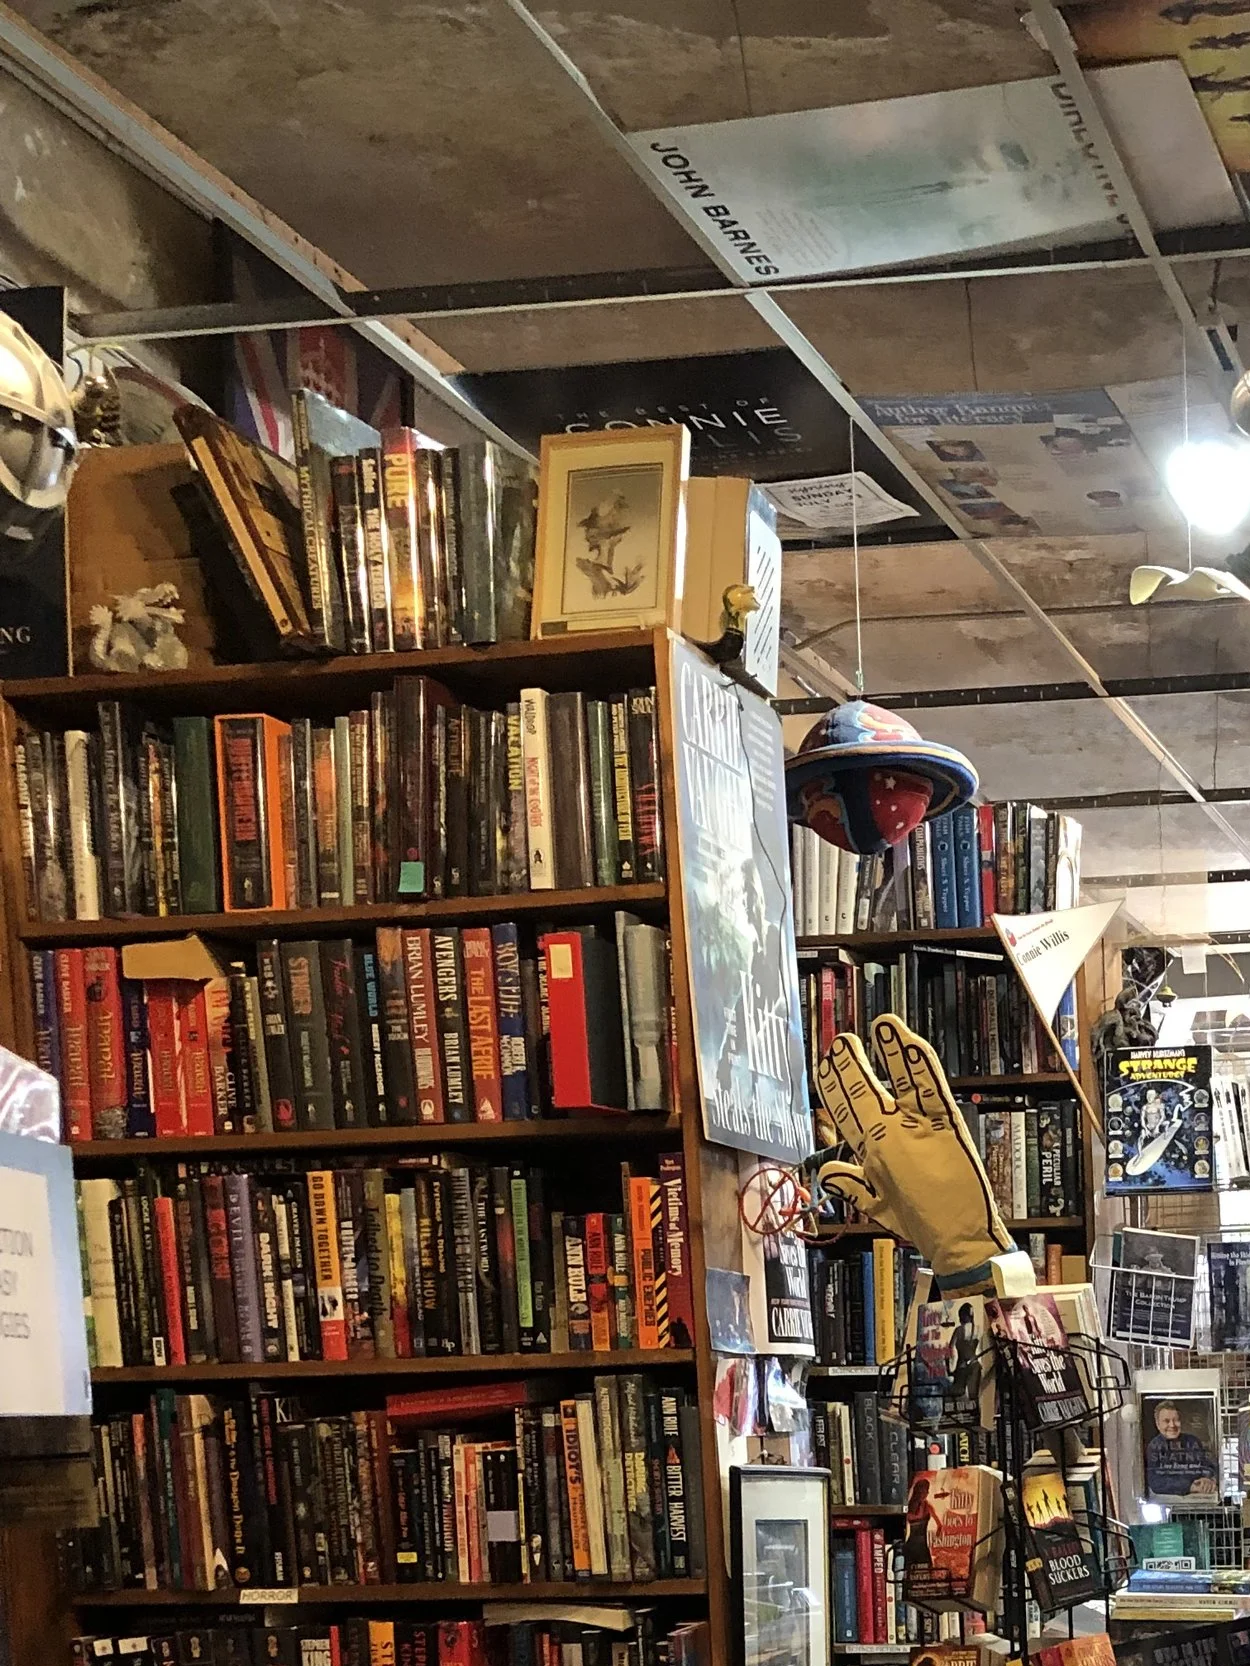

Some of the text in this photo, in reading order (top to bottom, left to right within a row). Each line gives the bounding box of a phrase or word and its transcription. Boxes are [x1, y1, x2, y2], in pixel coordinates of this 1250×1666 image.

[649, 140, 781, 279] JOHN BARNES
[383, 453, 409, 509] PURE
[679, 660, 744, 776] CARRIE
[915, 822, 926, 870] COMPANIONS
[364, 954, 377, 980] BLUE
[434, 935, 458, 1002] AVENGERS
[1017, 931, 1070, 966] Connie Willis
[405, 936, 429, 1043] BRIAN LUMLEY
[468, 967, 484, 995] THE
[468, 996, 492, 1032] LAST
[738, 969, 794, 1098] Kitty
[214, 1065, 227, 1116] BARKER
[226, 1072, 237, 1108] CLIVE
[442, 1032, 463, 1104] BRIAN LUMLEY
[1118, 1058, 1198, 1077] STRANGE
[710, 1075, 750, 1134] Steals
[751, 1085, 774, 1144] the
[1042, 1151, 1053, 1185] PERIL
[1052, 1149, 1061, 1186] PECULIAR
[312, 1176, 333, 1282] GO DOWN TOGETHER
[419, 1218, 434, 1267] KILLER
[588, 1232, 604, 1271] ANN RULE
[664, 1178, 685, 1277] Victims Memory
[565, 1236, 586, 1303] ANN RULE
[613, 1233, 627, 1273] ANN RULE
[258, 1232, 279, 1329] DARK NIGHT
[1041, 1375, 1065, 1394] World
[662, 1396, 679, 1436] ANN RULE
[564, 1428, 582, 1485] IDIOT'S
[634, 1452, 646, 1494] DARING
[890, 1431, 901, 1485] CLEAR
[624, 1452, 637, 1512] DETECTIVES
[666, 1465, 686, 1542] BITTER HARVEST
[873, 1543, 884, 1574] AMPED
[927, 1532, 973, 1550] Washington
[1048, 1555, 1082, 1572] BLOOD
[241, 1590, 293, 1602] HORROR
[1048, 1566, 1091, 1585] SUCKERS
